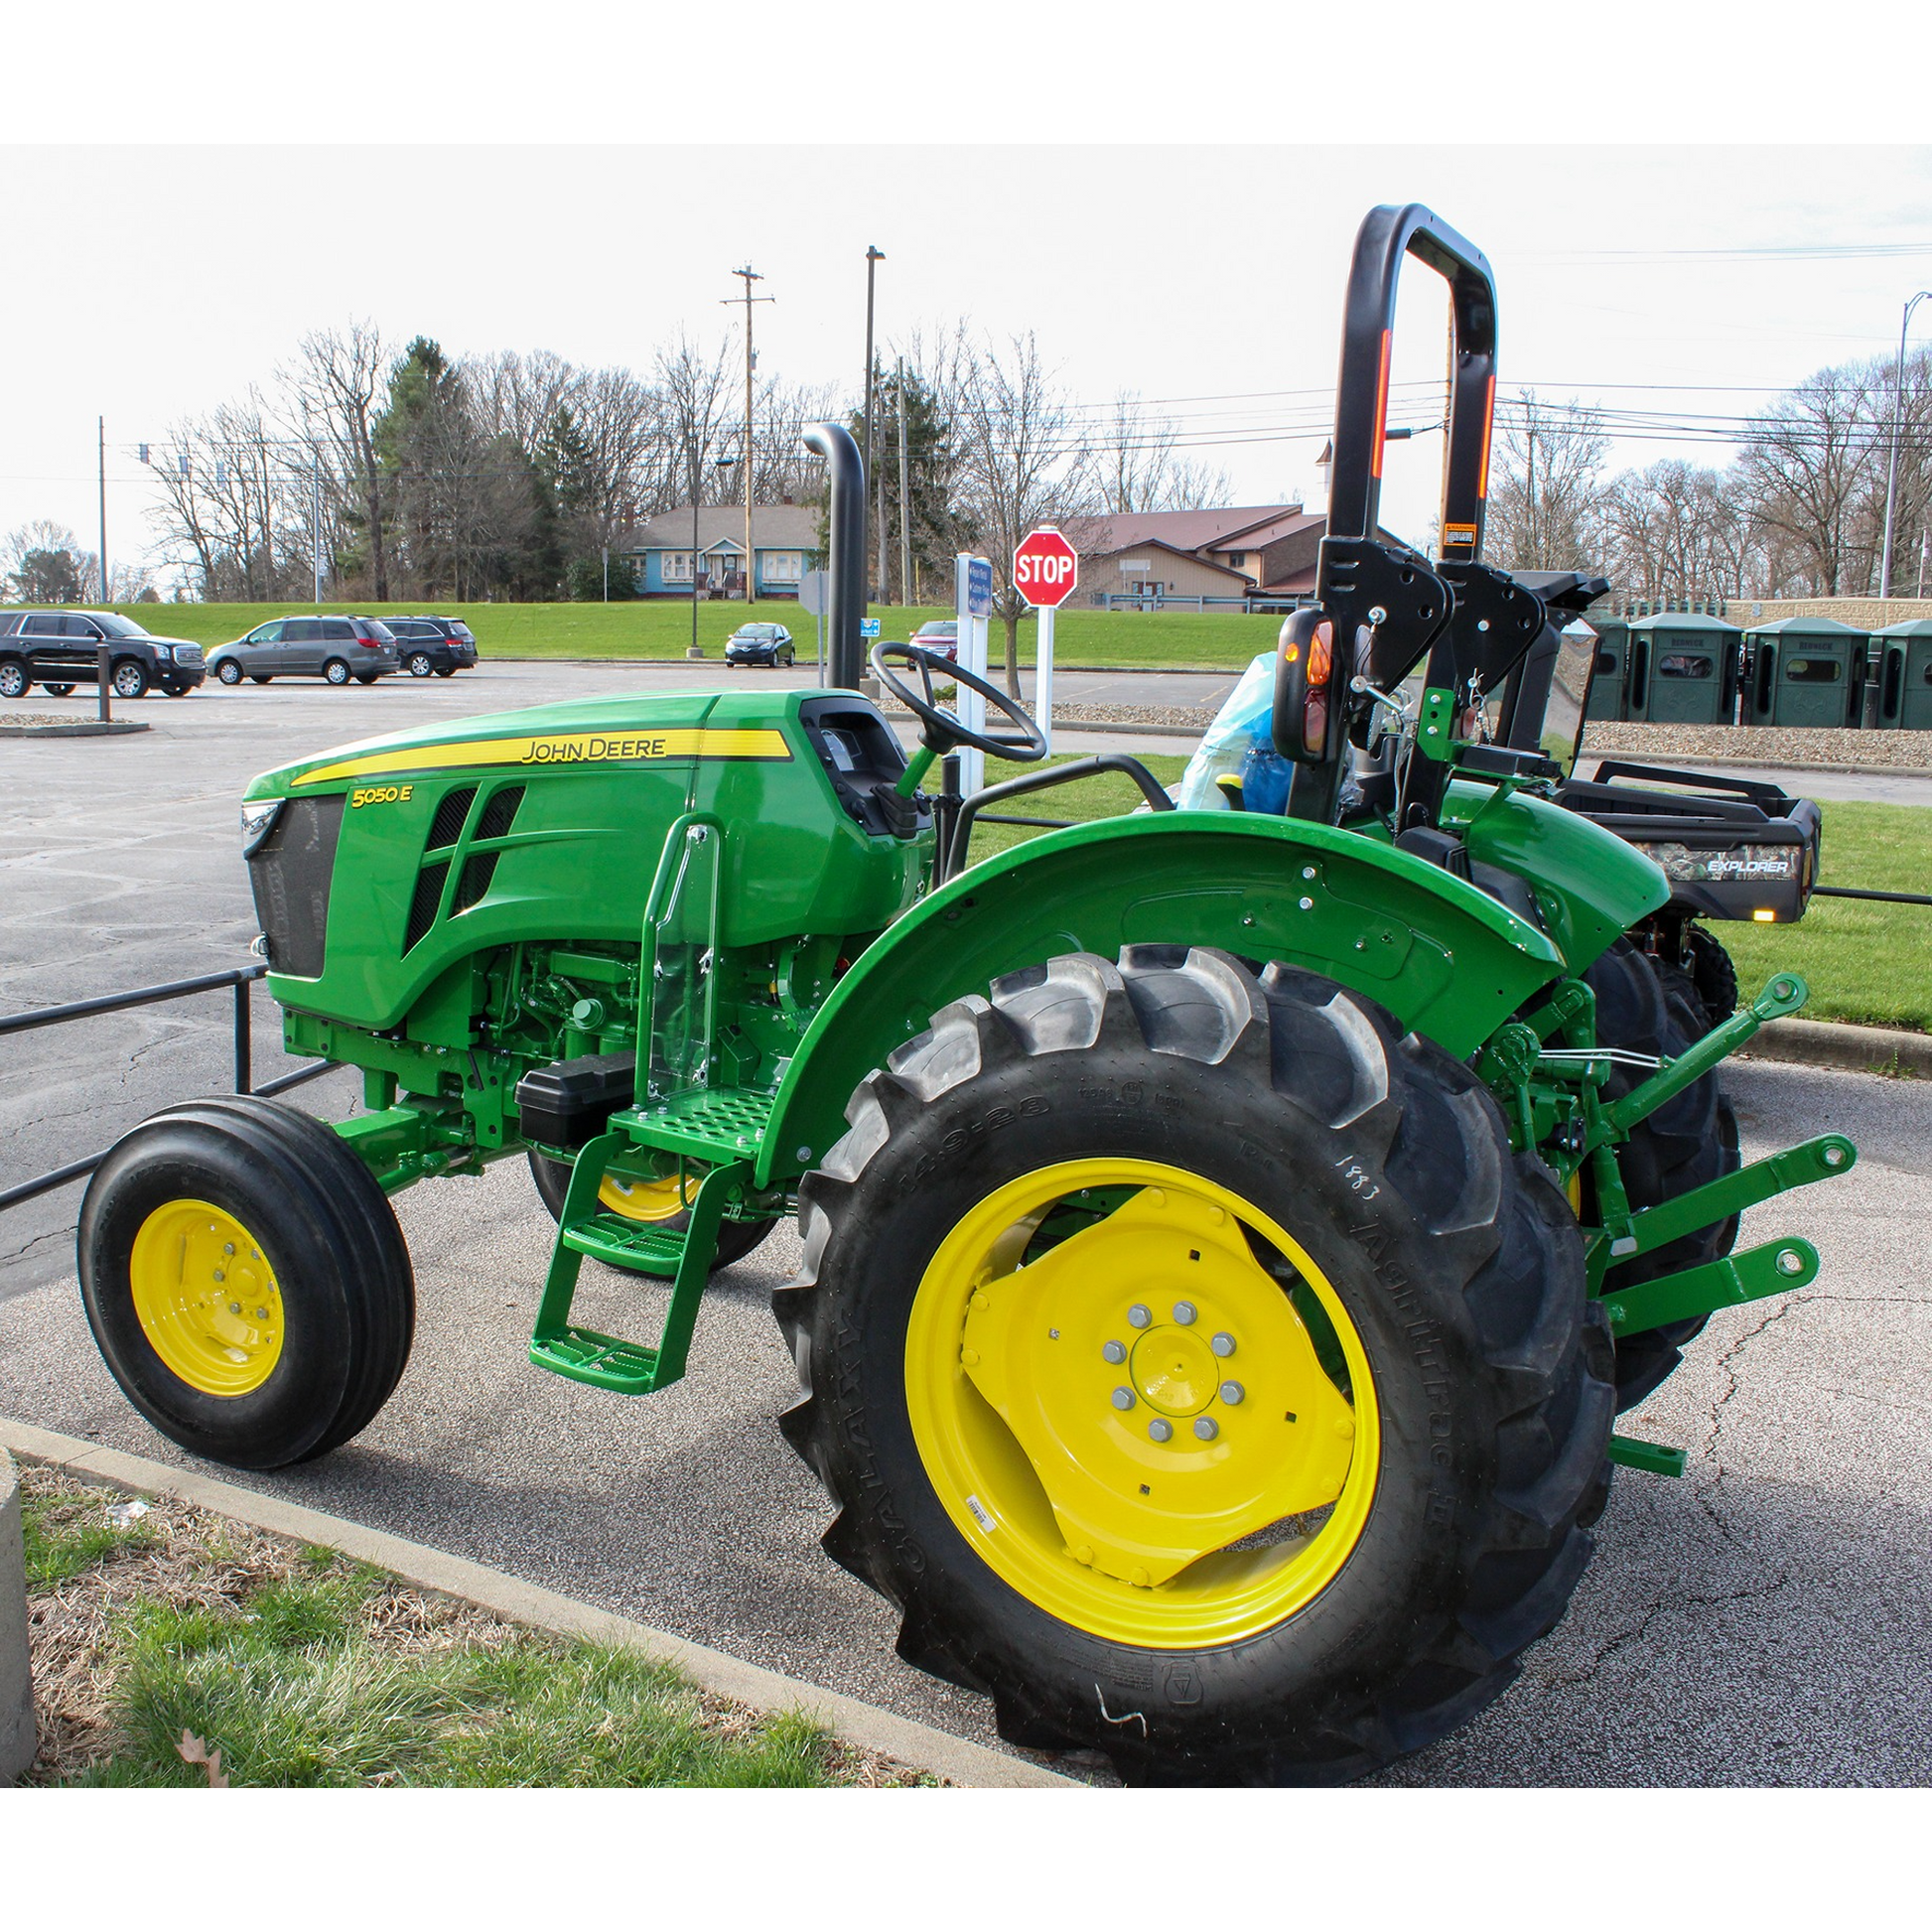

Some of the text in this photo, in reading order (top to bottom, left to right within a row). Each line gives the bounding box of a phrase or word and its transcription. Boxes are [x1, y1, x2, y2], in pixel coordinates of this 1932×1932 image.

[1018, 554, 1073, 584] STOP
[521, 738, 666, 762] JOHN DEERE
[351, 786, 399, 809] 5050
[1708, 860, 1789, 874] EXPLORER
[1334, 1155, 1381, 1200] 1883
[838, 1309, 926, 1574] GALAXY
